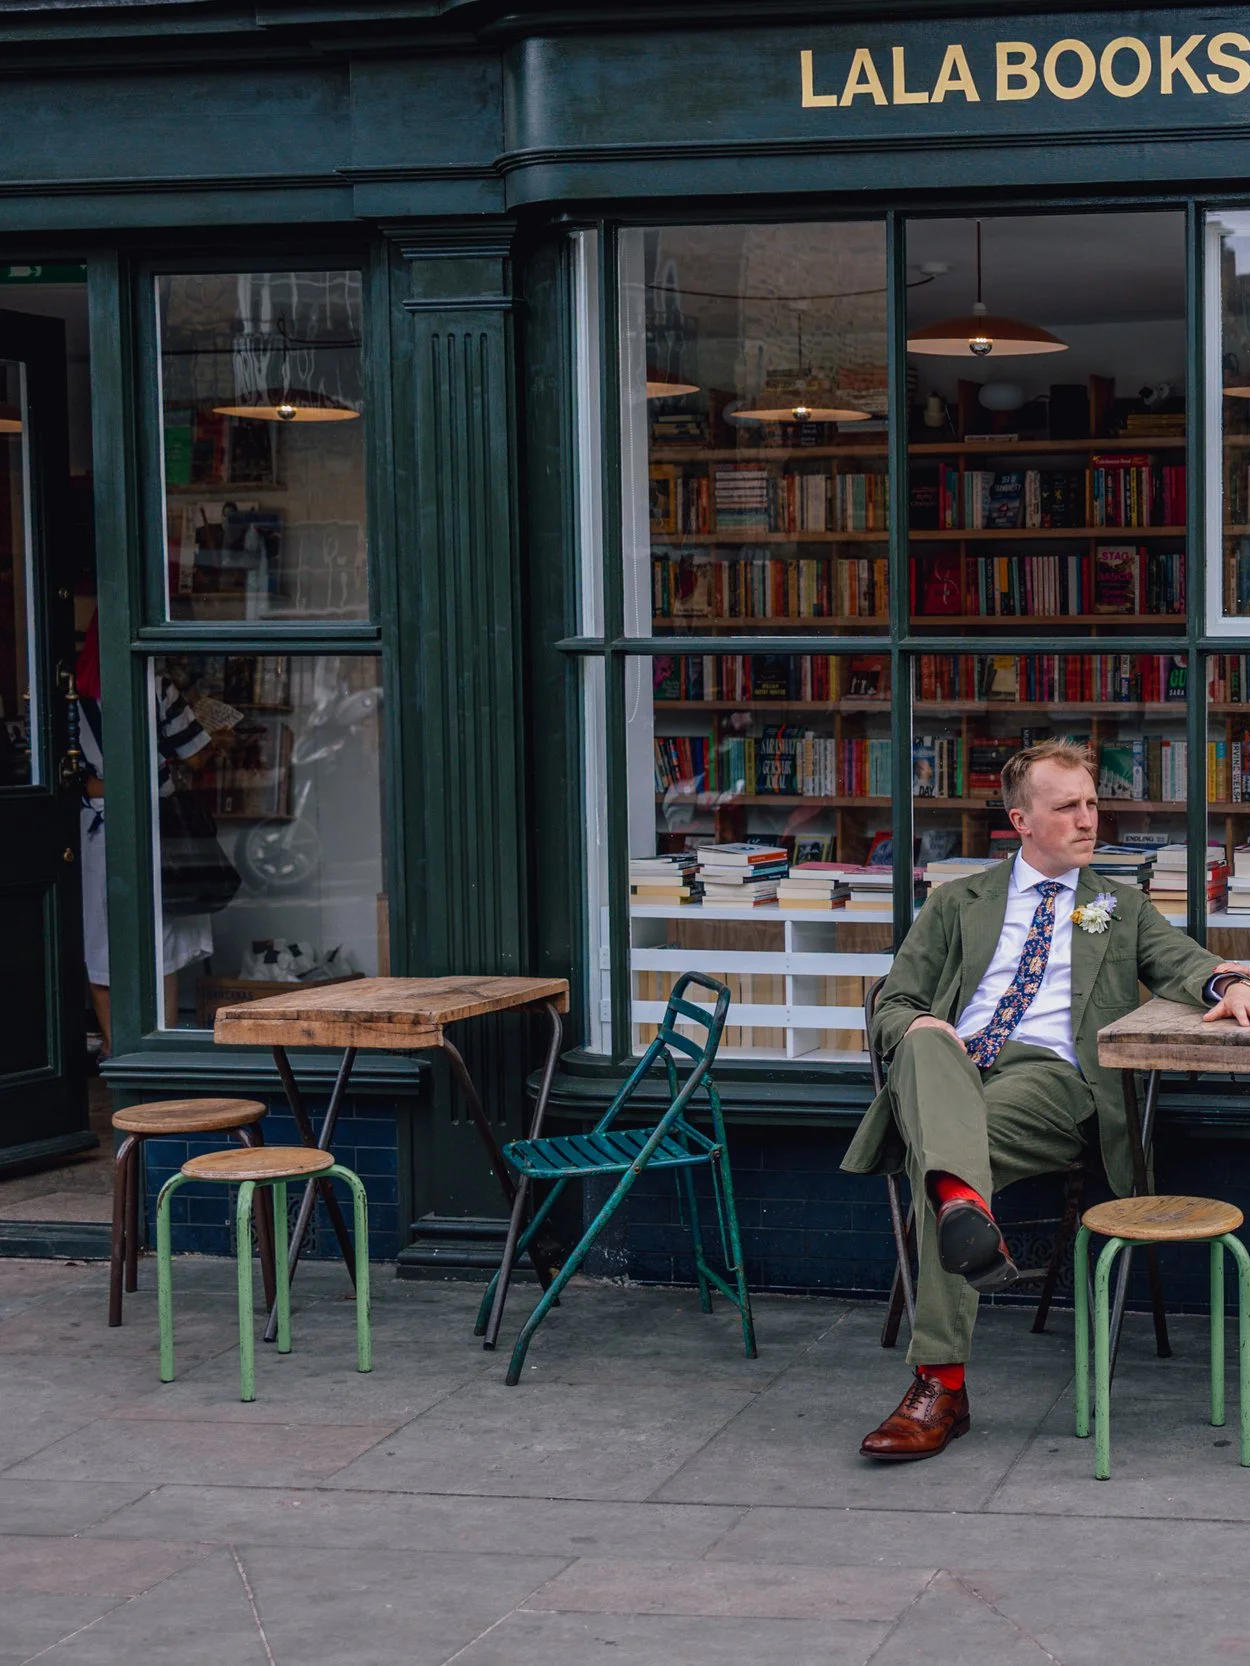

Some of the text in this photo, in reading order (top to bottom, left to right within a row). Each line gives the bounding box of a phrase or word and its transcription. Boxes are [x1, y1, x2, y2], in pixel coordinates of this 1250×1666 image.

[800, 44, 980, 108] LALA
[1102, 551, 1129, 561] STAG
[1232, 742, 1241, 803] IRVINE WELSH
[918, 785, 935, 797] DAY
